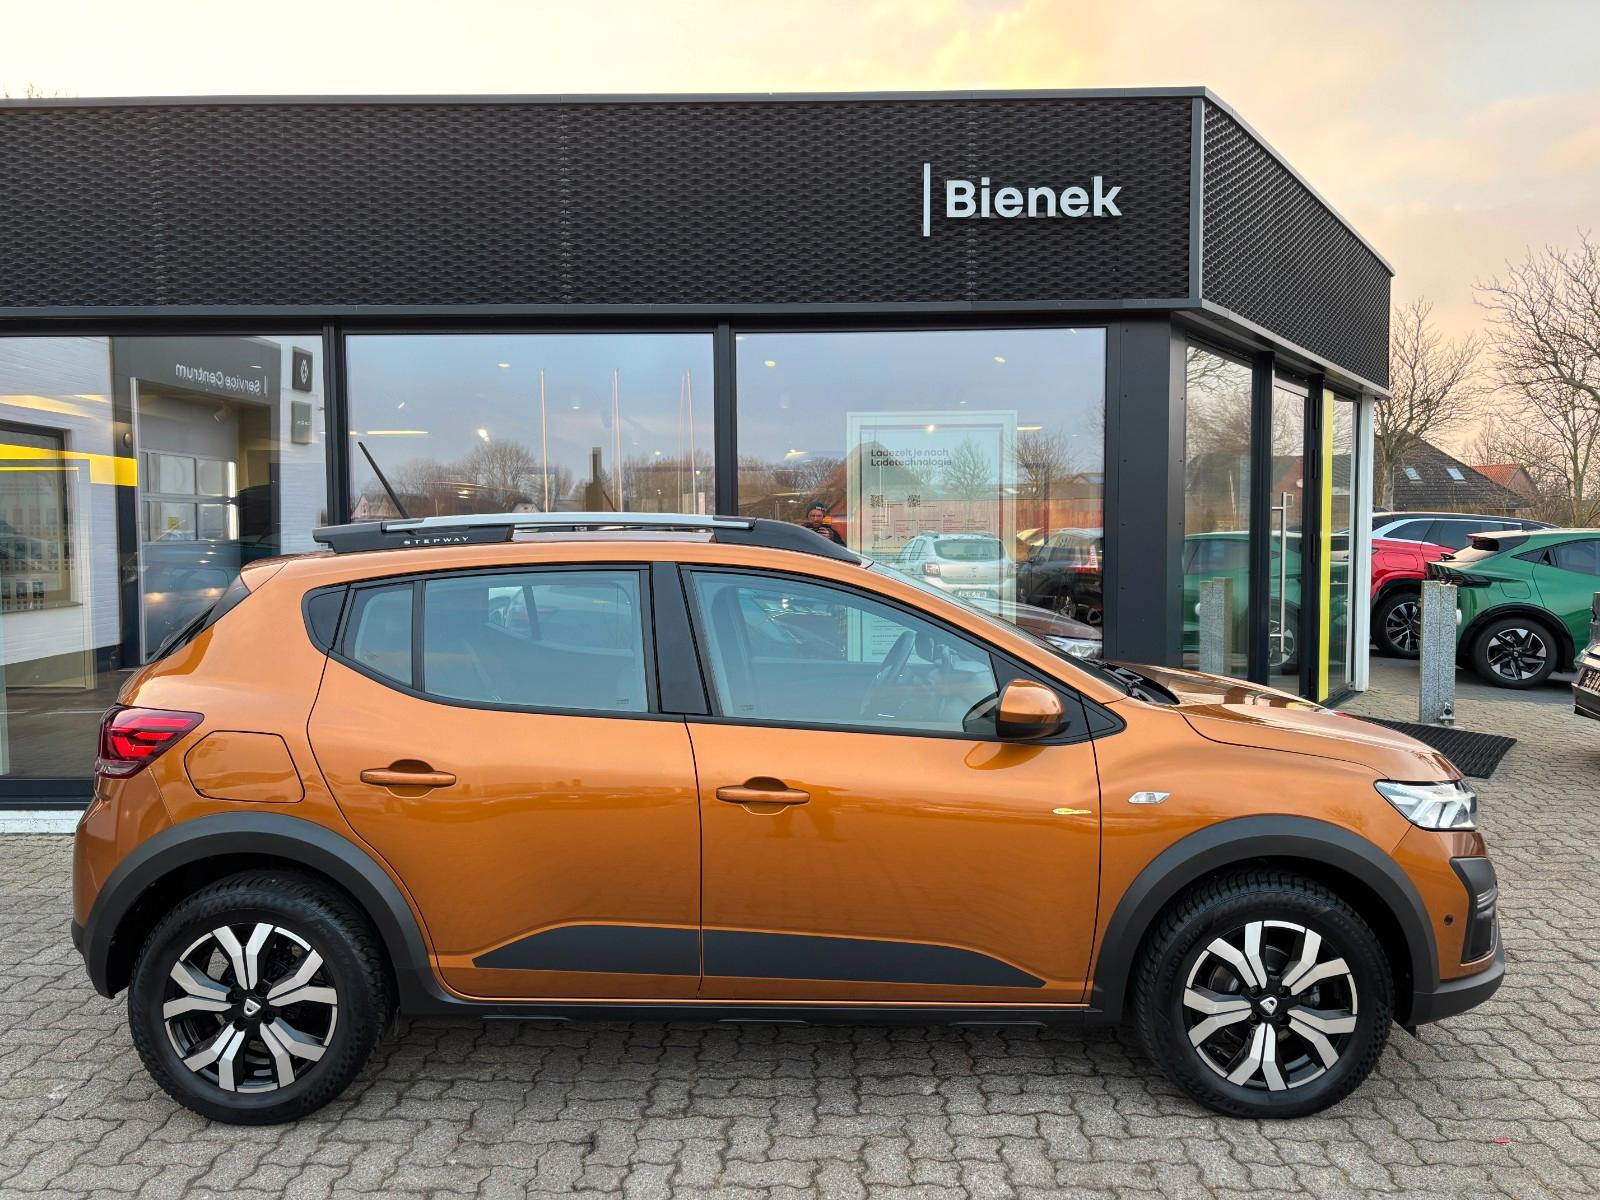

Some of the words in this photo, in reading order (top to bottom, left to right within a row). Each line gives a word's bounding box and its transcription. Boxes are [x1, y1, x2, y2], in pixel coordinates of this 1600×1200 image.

[946, 175, 1123, 218] Bienek
[924, 448, 949, 457] nach
[871, 457, 952, 467] Ladetechnologie
[403, 536, 468, 544] STEPWAY
